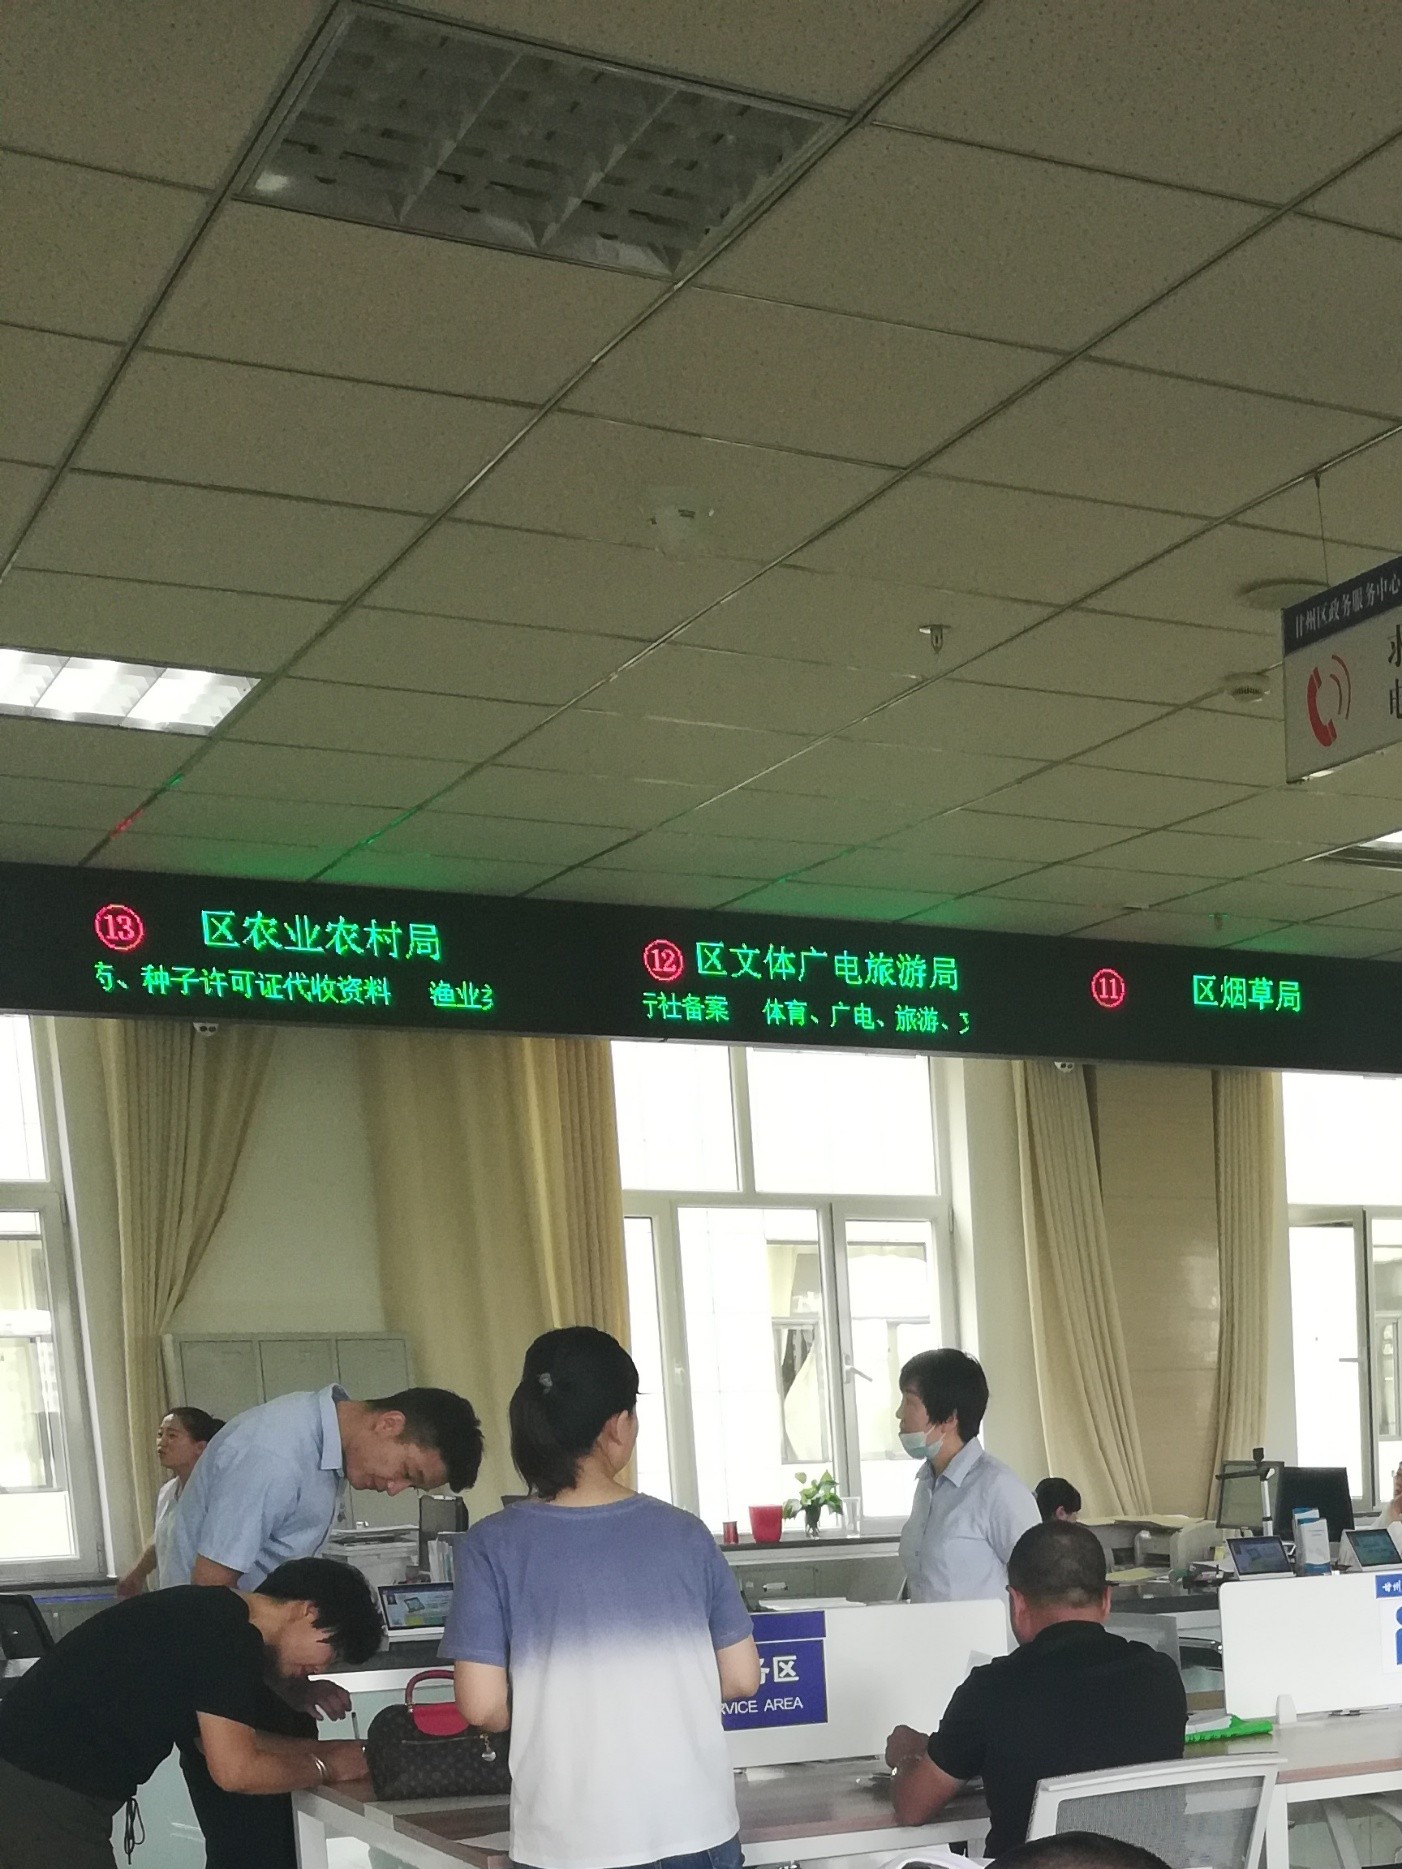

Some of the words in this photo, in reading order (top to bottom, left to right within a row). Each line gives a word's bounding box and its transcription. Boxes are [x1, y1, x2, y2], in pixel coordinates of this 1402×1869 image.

[201, 909, 442, 962] 区农业农村局
[695, 941, 960, 993] 区文体广电旅游局
[1192, 974, 1301, 1013] 区烟草局
[763, 1696, 804, 1712] AREA
